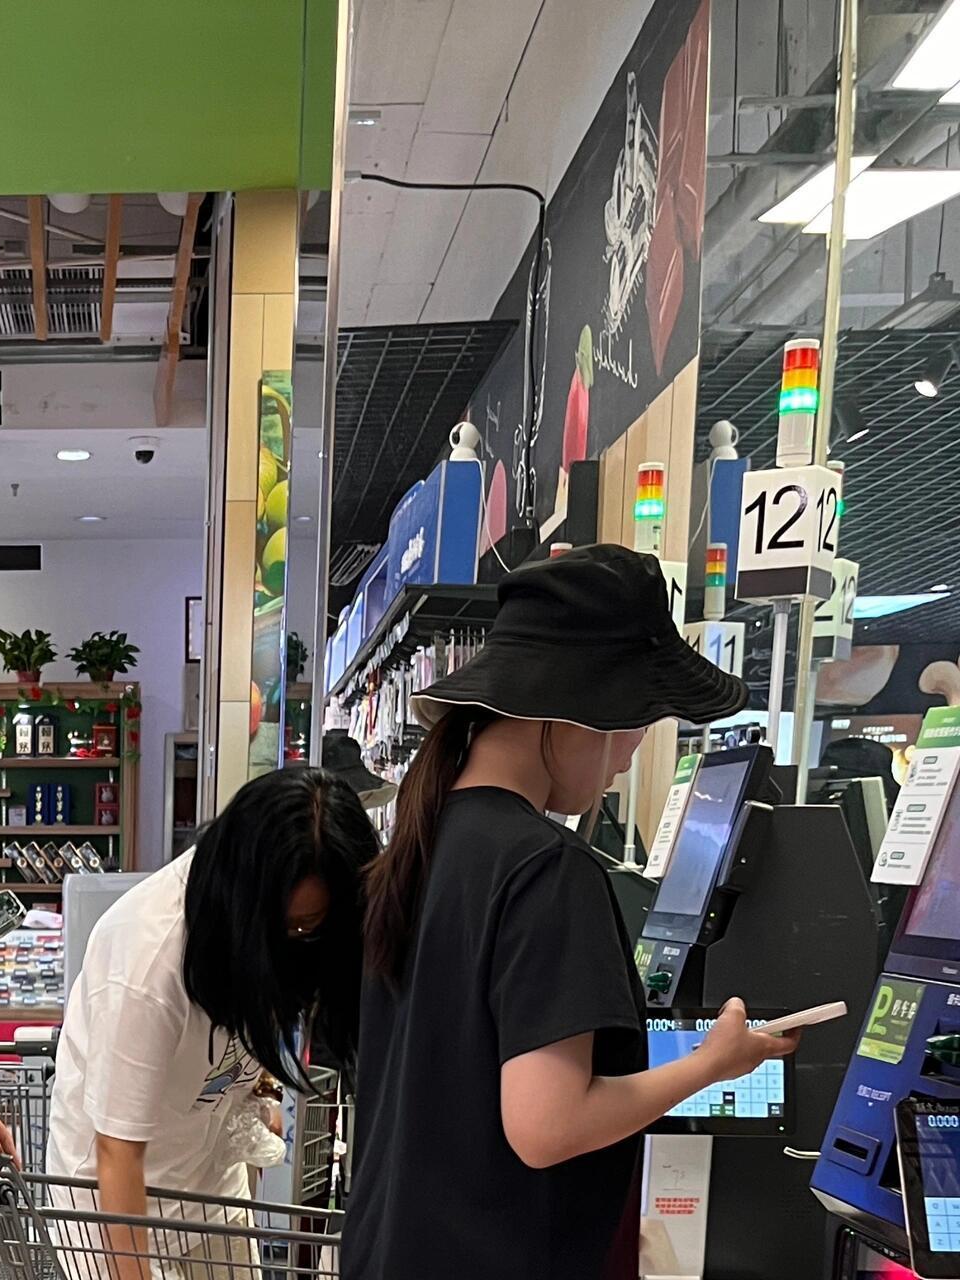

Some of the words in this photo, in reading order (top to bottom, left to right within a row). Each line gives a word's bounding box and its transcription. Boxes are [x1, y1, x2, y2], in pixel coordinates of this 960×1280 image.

[744, 484, 808, 555] 12
[816, 486, 838, 553] 12
[841, 575, 857, 625] 12
[709, 633, 736, 674] 11
